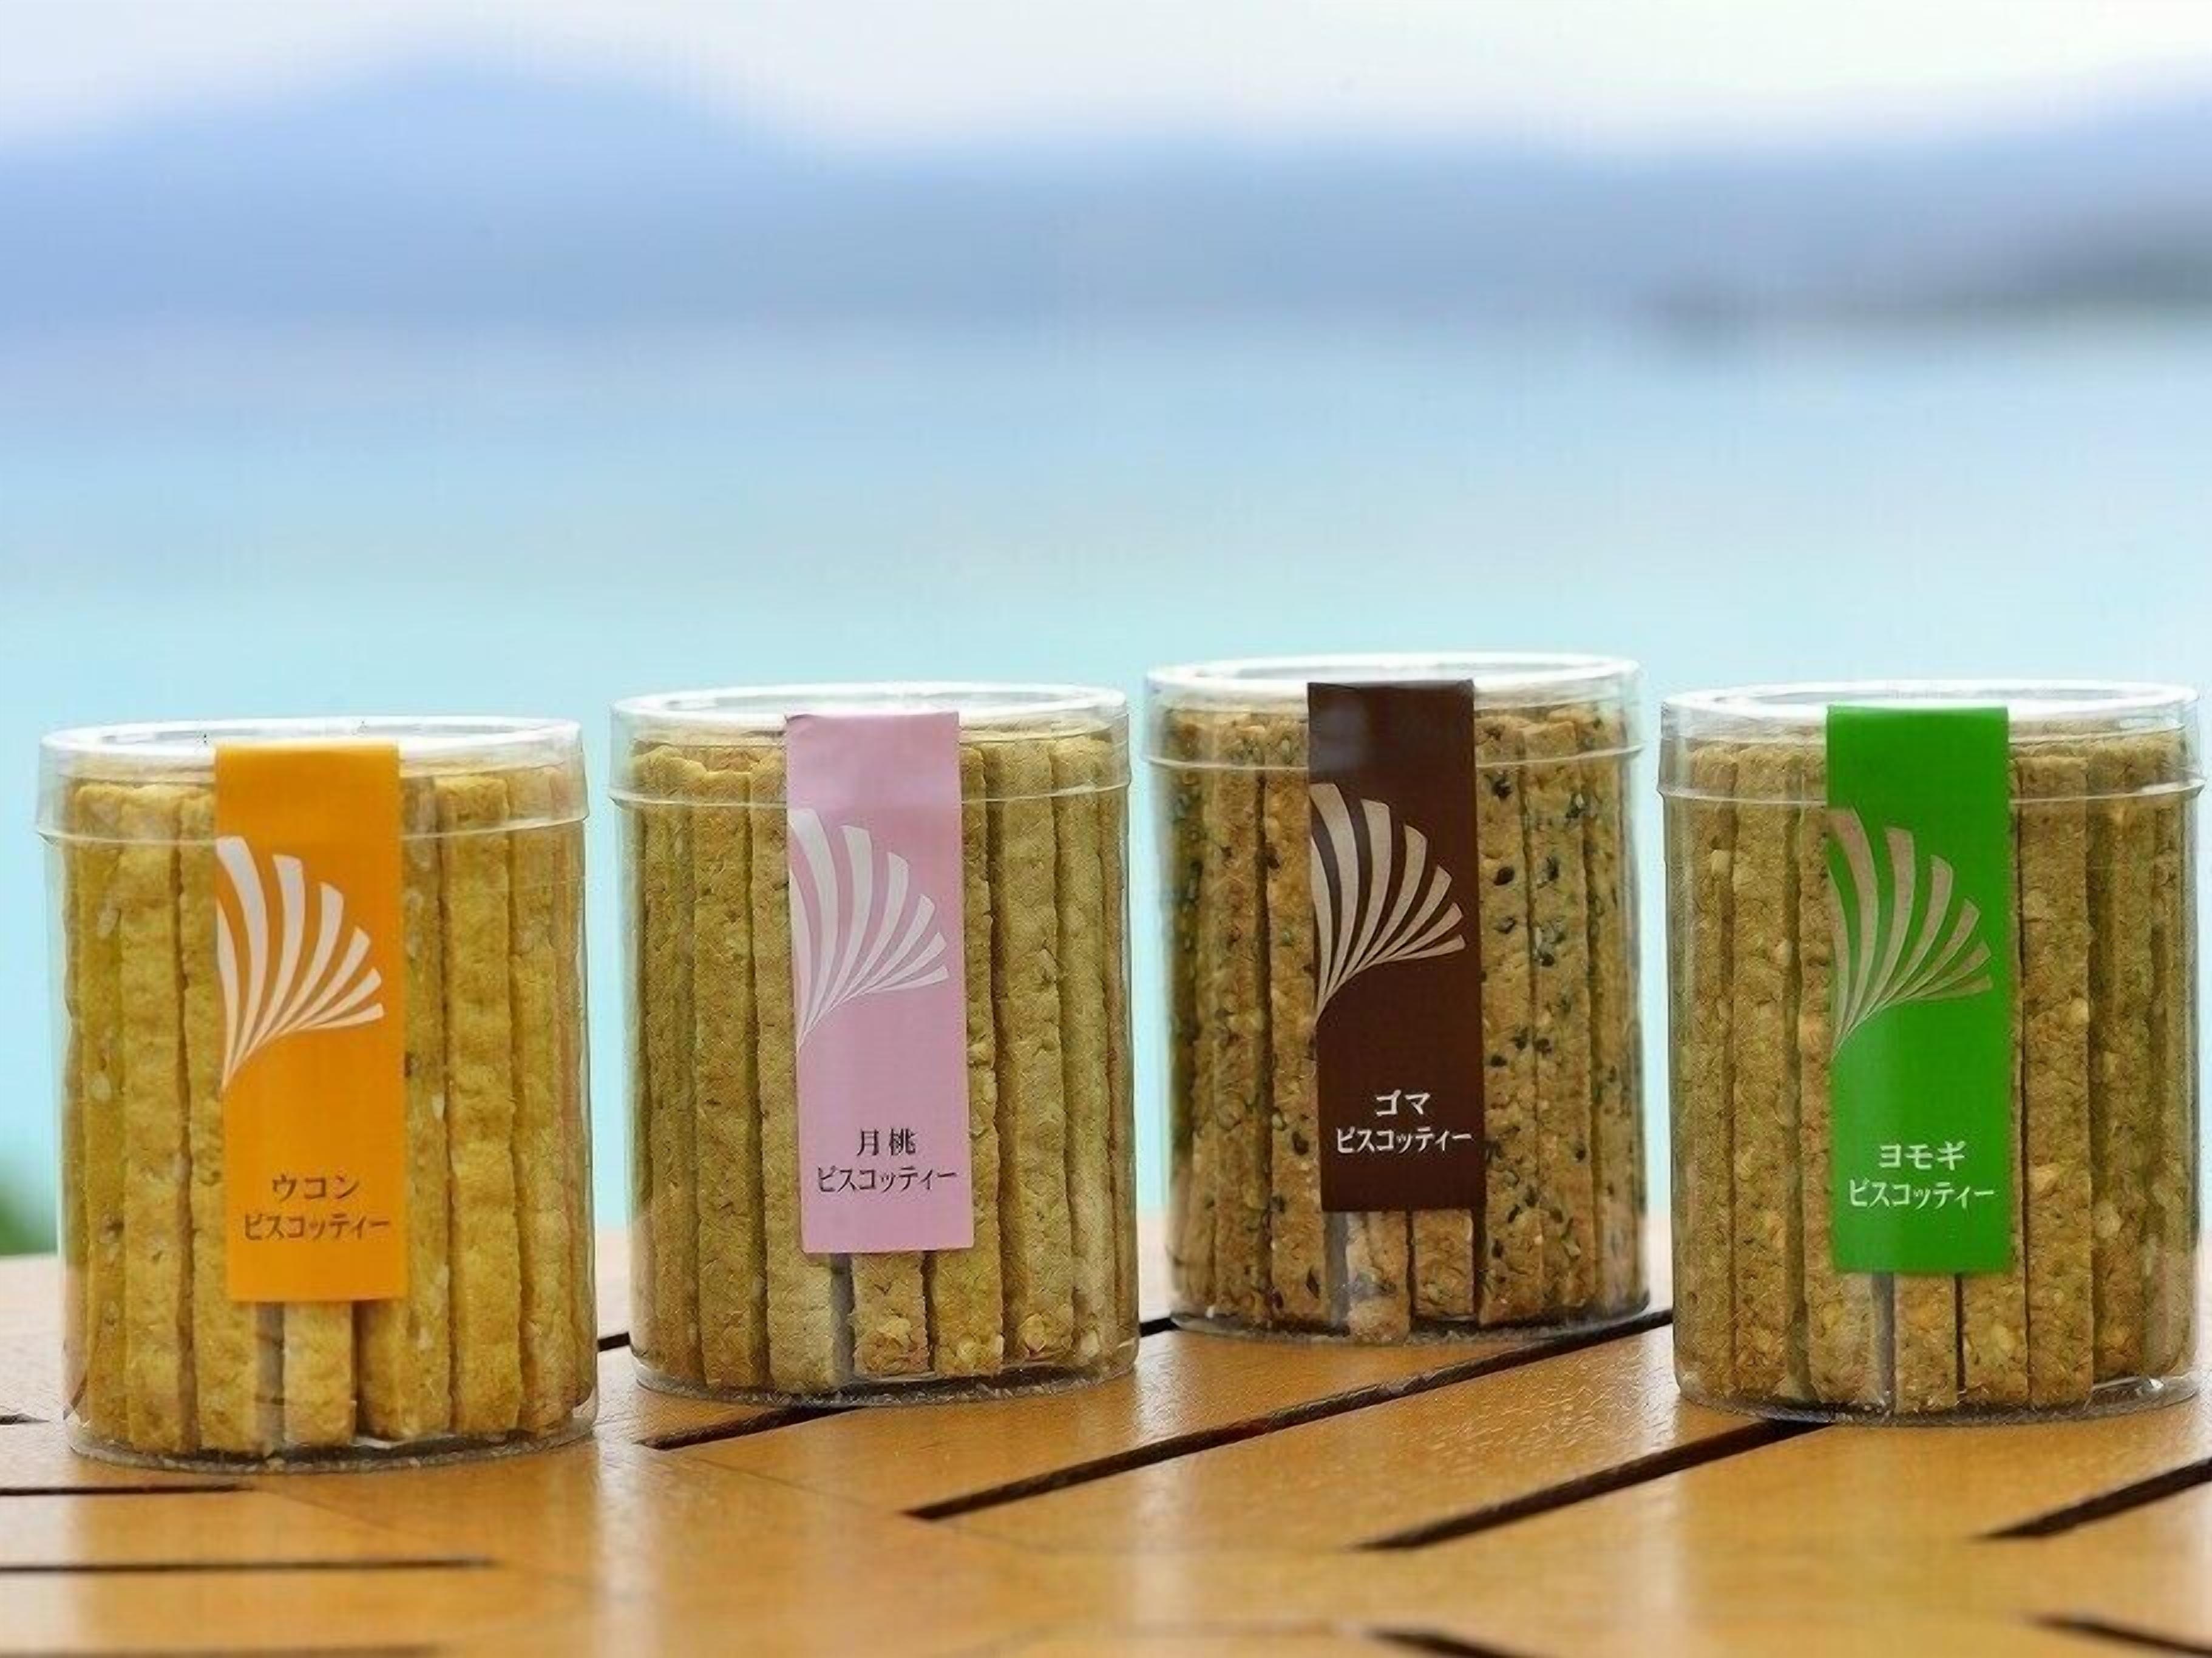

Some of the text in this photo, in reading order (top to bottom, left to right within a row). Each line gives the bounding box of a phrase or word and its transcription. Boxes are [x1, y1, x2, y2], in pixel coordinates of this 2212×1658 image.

[1376, 1089, 1431, 1117] ゴマ
[857, 1128, 915, 1156] 月桃
[1337, 1126, 1472, 1153] ビスコッティー
[1879, 1141, 1966, 1171] ヨモギ
[272, 1174, 359, 1202] ウコン
[818, 1165, 957, 1193] ビスコッティー
[1850, 1178, 1995, 1210] ビスコッティー
